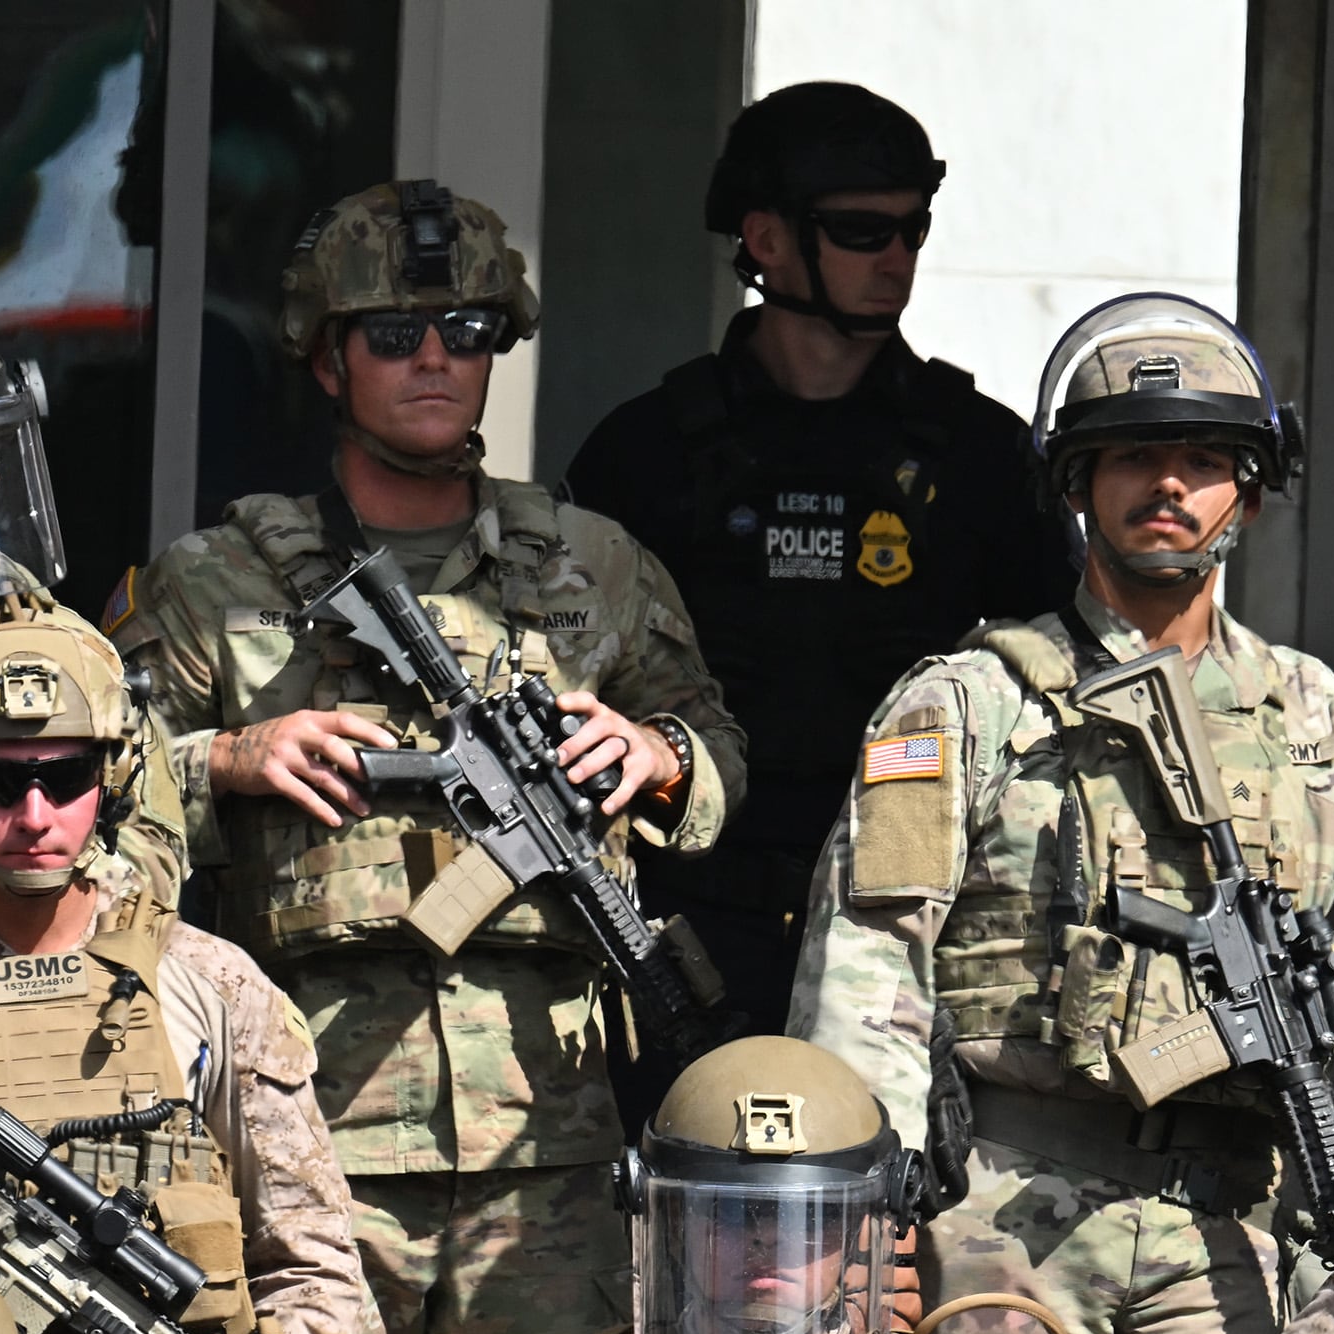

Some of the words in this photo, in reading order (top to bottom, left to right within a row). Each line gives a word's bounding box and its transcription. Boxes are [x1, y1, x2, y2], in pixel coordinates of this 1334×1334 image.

[766, 526, 843, 557] POLICE
[544, 610, 589, 629] ARMY
[4, 976, 74, 991] 1537234810
